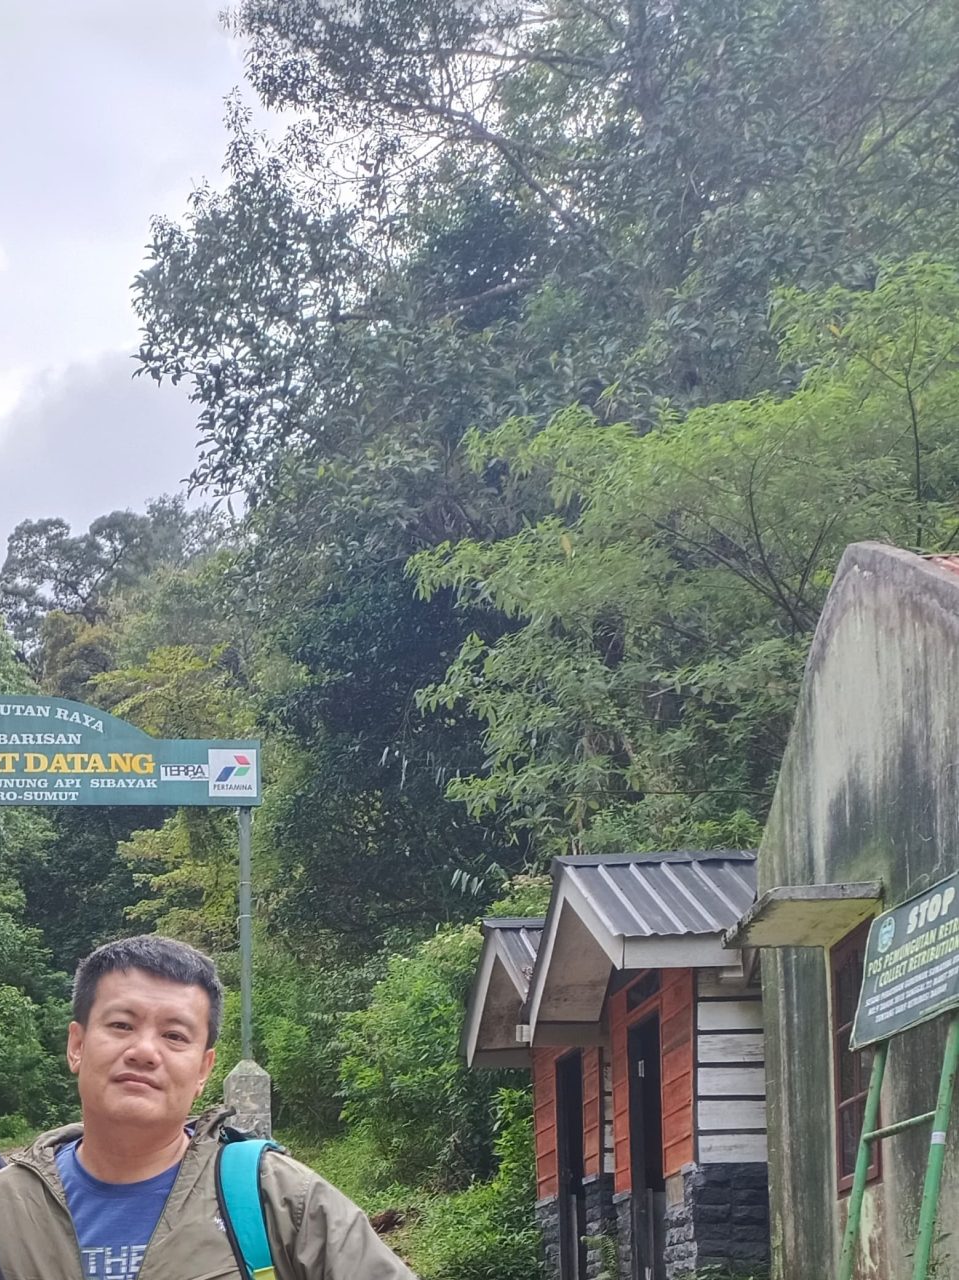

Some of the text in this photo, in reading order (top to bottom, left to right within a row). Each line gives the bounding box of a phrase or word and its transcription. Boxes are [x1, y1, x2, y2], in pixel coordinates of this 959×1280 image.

[54, 707, 104, 734] RAYA
[23, 752, 156, 775] DATANG
[161, 764, 206, 777] TERRA
[54, 778, 81, 788] API
[90, 778, 158, 788] SIBAYAK
[906, 886, 956, 935] STOP
[867, 956, 884, 977] POS
[878, 960, 908, 988] COLLECT
[81, 1244, 147, 1274] THE
